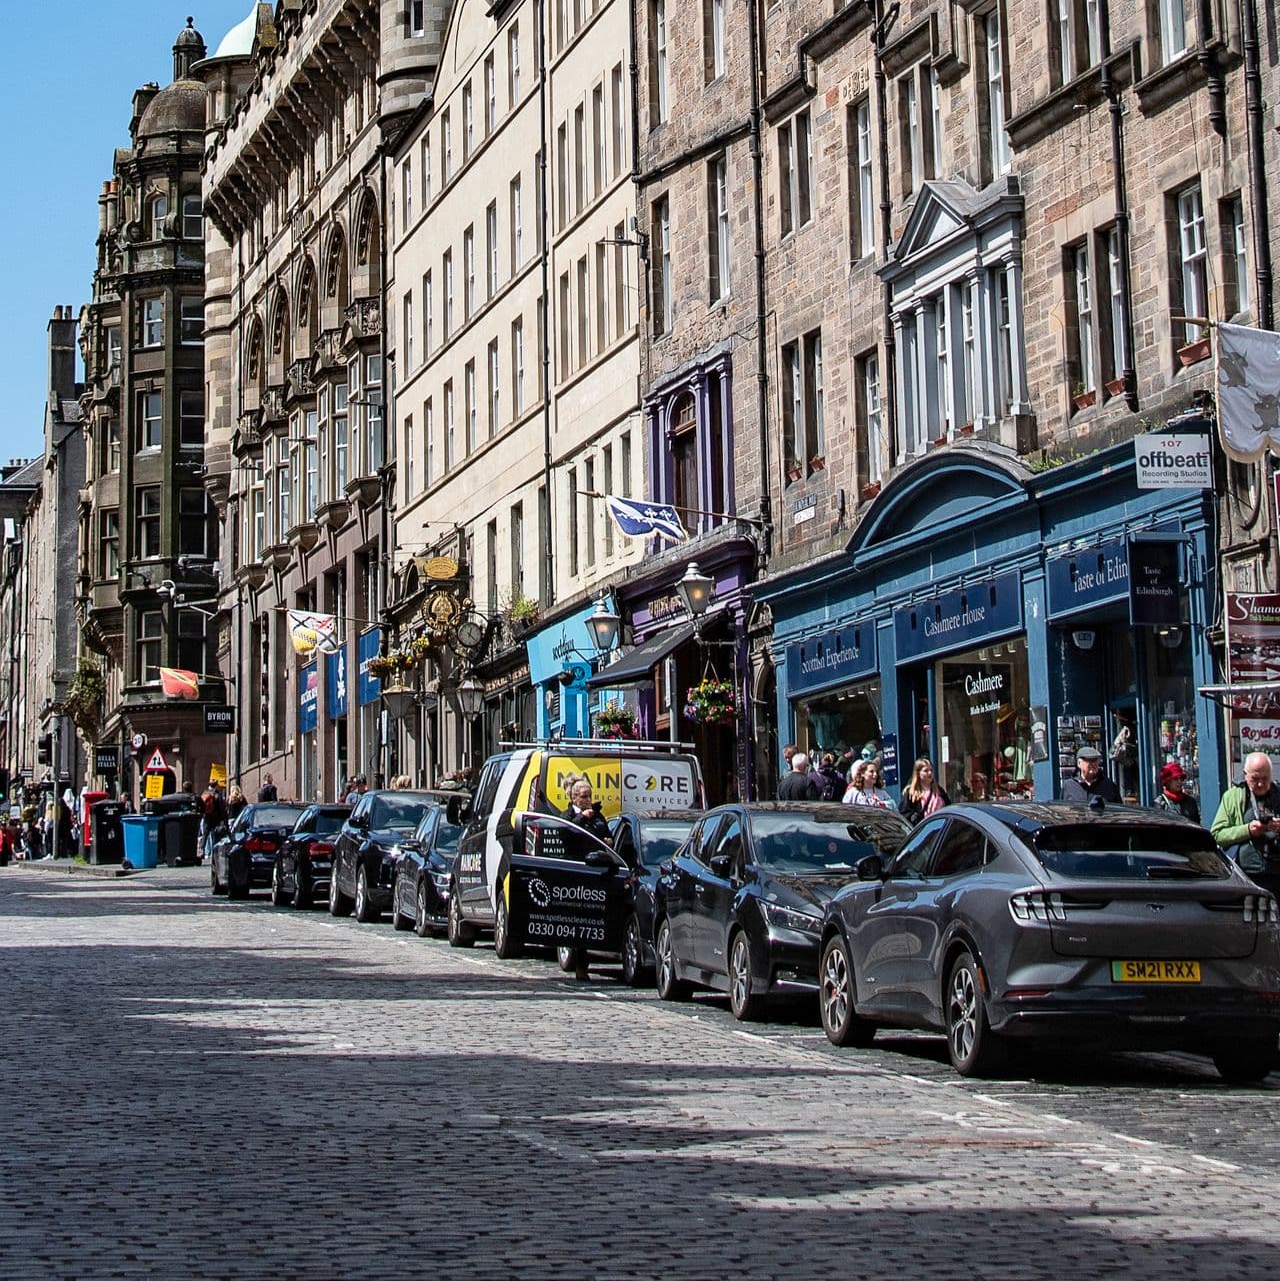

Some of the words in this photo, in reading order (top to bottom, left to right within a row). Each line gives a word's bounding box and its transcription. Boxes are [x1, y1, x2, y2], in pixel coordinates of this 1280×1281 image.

[1138, 451, 1204, 468] offbeat
[1142, 470, 1179, 478] Recording
[1107, 557, 1129, 581] Edin
[1143, 566, 1162, 575] Taste
[1150, 577, 1158, 585] of
[1136, 587, 1173, 596] Edinburgh
[924, 616, 961, 637] Cashmere
[962, 605, 986, 628] House
[826, 645, 859, 670] Experience
[965, 671, 1004, 696] Cashmere
[207, 712, 231, 721] BYRON
[1241, 725, 1273, 741] Royal
[635, 796, 689, 805] SERVICES
[552, 885, 607, 902] spotless
[528, 922, 555, 936] 0330
[556, 924, 576, 938] 094
[579, 926, 605, 940] 7733
[1126, 962, 1161, 978] SM21
[1164, 963, 1195, 978] RXX
